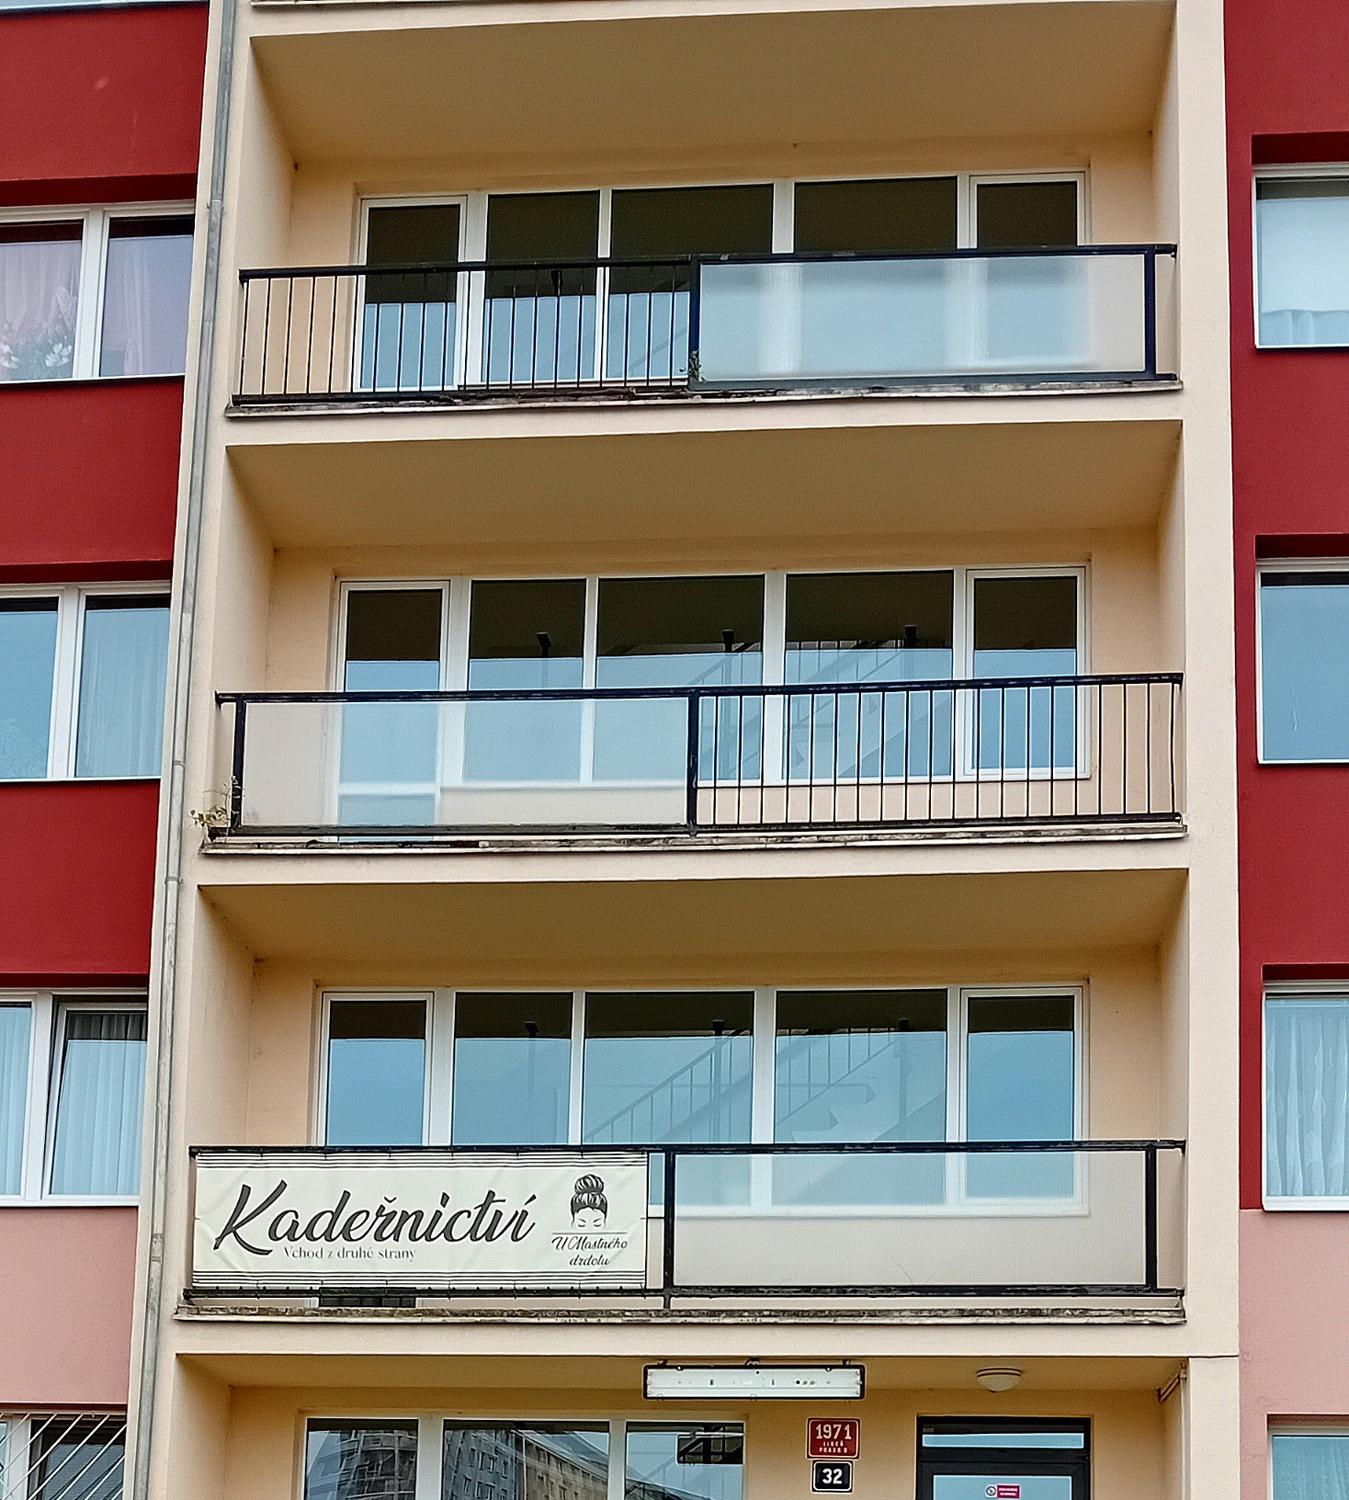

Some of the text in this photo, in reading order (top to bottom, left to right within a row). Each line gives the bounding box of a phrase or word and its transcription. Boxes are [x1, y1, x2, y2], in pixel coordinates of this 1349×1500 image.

[213, 1179, 536, 1255] Kadeřnictví
[551, 1236, 568, 1251] U
[284, 1247, 415, 1262] Vchod z druhé strany
[569, 1254, 609, 1266] drdolu
[815, 1423, 852, 1440] 1971
[822, 1468, 843, 1485] 32
